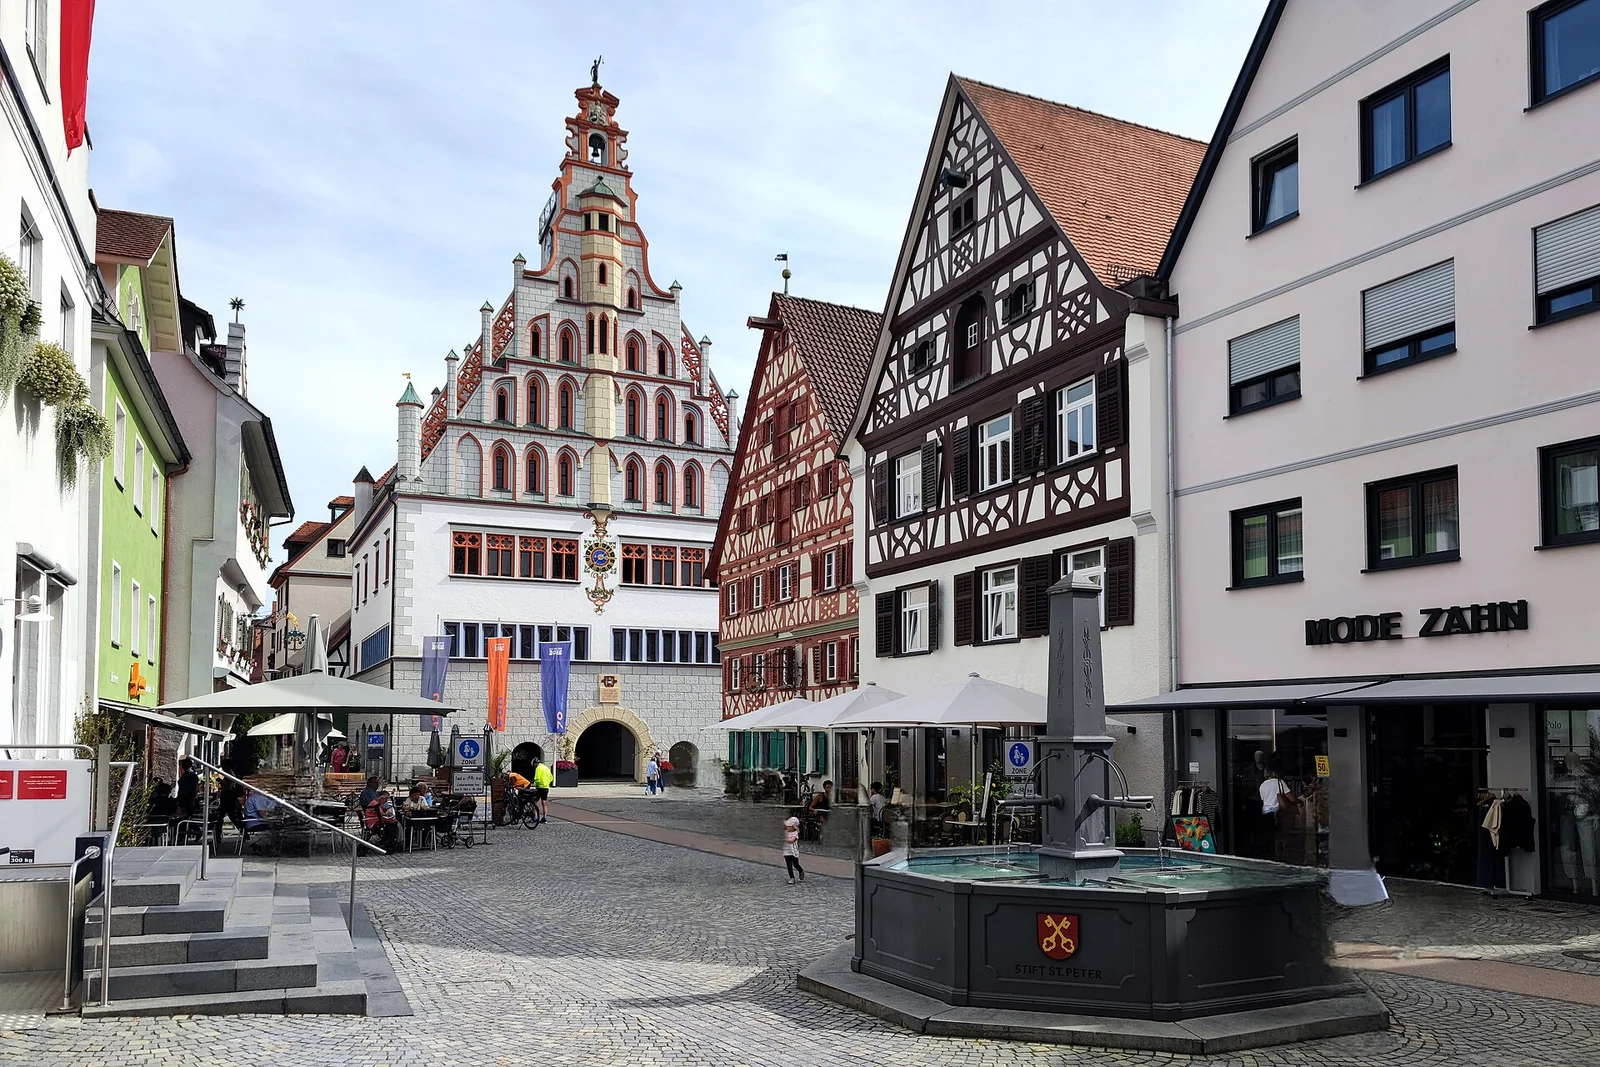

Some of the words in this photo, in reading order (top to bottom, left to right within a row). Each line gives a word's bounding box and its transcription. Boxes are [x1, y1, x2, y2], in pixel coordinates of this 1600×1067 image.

[1305, 612, 1403, 646] MODE
[1419, 599, 1529, 638] ZAHN
[1014, 964, 1046, 976] STIFT
[1048, 966, 1064, 977] ST.
[1066, 967, 1103, 980] PETER
